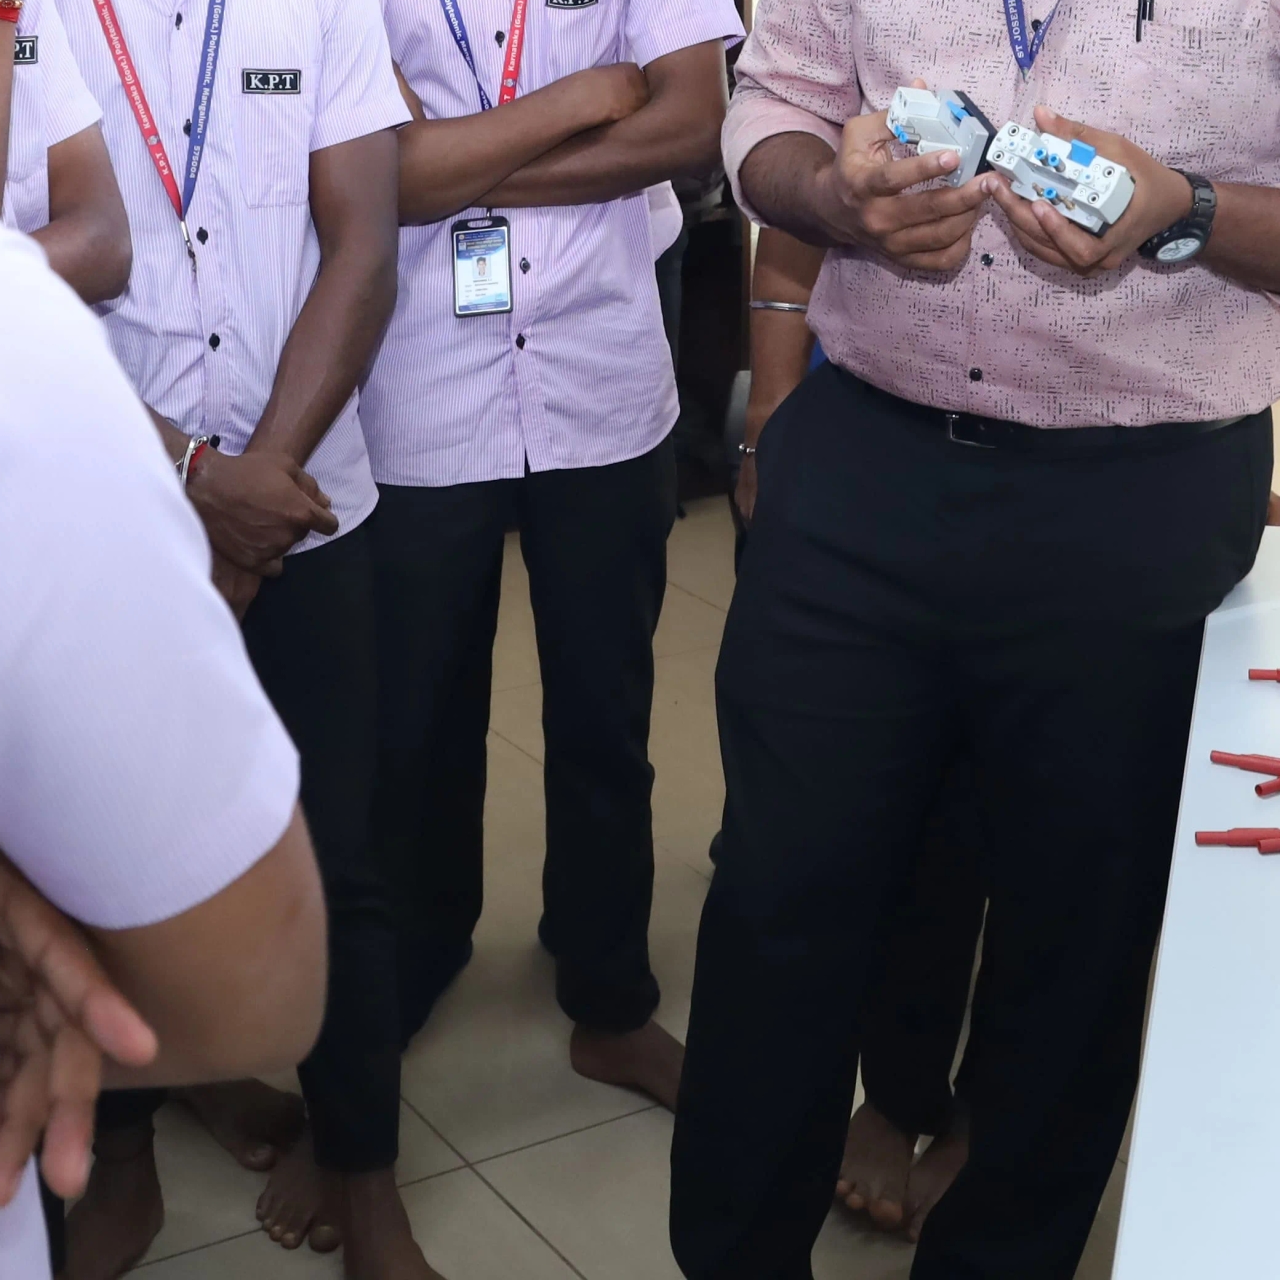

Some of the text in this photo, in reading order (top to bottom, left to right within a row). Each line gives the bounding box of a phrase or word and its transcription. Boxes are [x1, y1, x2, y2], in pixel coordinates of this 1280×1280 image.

[102, 5, 123, 57] Polytechnic,
[209, 4, 223, 34] (Govt.)
[1007, 0, 1022, 43] JOSEPH
[14, 42, 33, 59] P.T
[203, 34, 218, 86] Polytechnic,
[508, 29, 519, 72] Karnataka
[1015, 44, 1024, 58] ST
[118, 55, 135, 85] (Govt.)
[249, 73, 294, 90] K.P.T
[131, 86, 151, 130] Karnataka
[197, 87, 211, 134] Mangaluru
[155, 152, 170, 175] K.P.T
[189, 145, 201, 179] 575004
